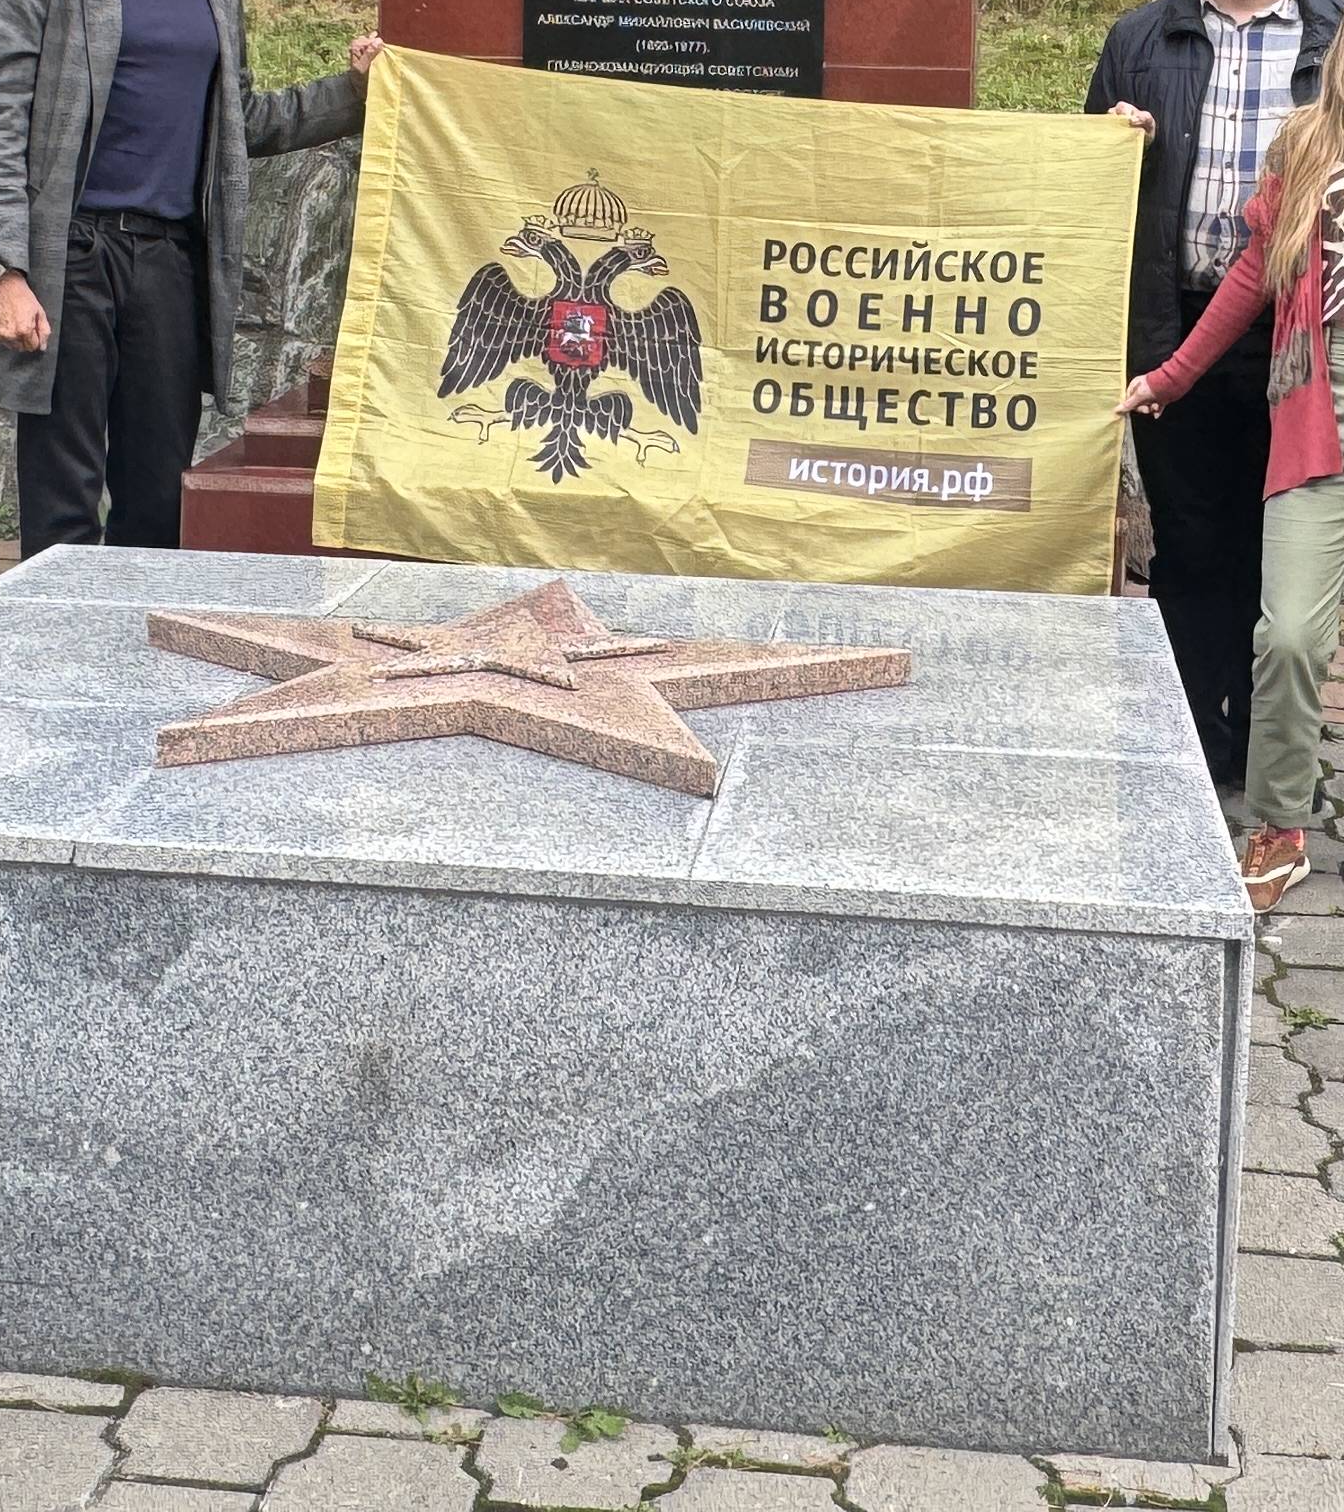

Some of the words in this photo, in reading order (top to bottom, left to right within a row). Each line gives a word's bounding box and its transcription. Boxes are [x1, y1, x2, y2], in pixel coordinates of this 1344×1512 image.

[537, 13, 615, 28] АЛЕКСАНДР
[618, 14, 709, 30] МИХАЙЛОВИЧ
[713, 18, 810, 32] ВАСИЛЕВСКИЙ
[547, 59, 704, 77] ГЛАВНОКОМАНДУЮЩИЙ
[708, 65, 799, 77] СОВЕТСКИМИ
[763, 239, 1045, 284] РОССИЙСКОЕ
[760, 284, 1042, 337] ВОЕННО
[756, 336, 1038, 379] ИСТОРИЧЕСКОЕ
[753, 378, 1038, 432] ОБЩЕСТВО
[788, 456, 993, 502] история.рф
